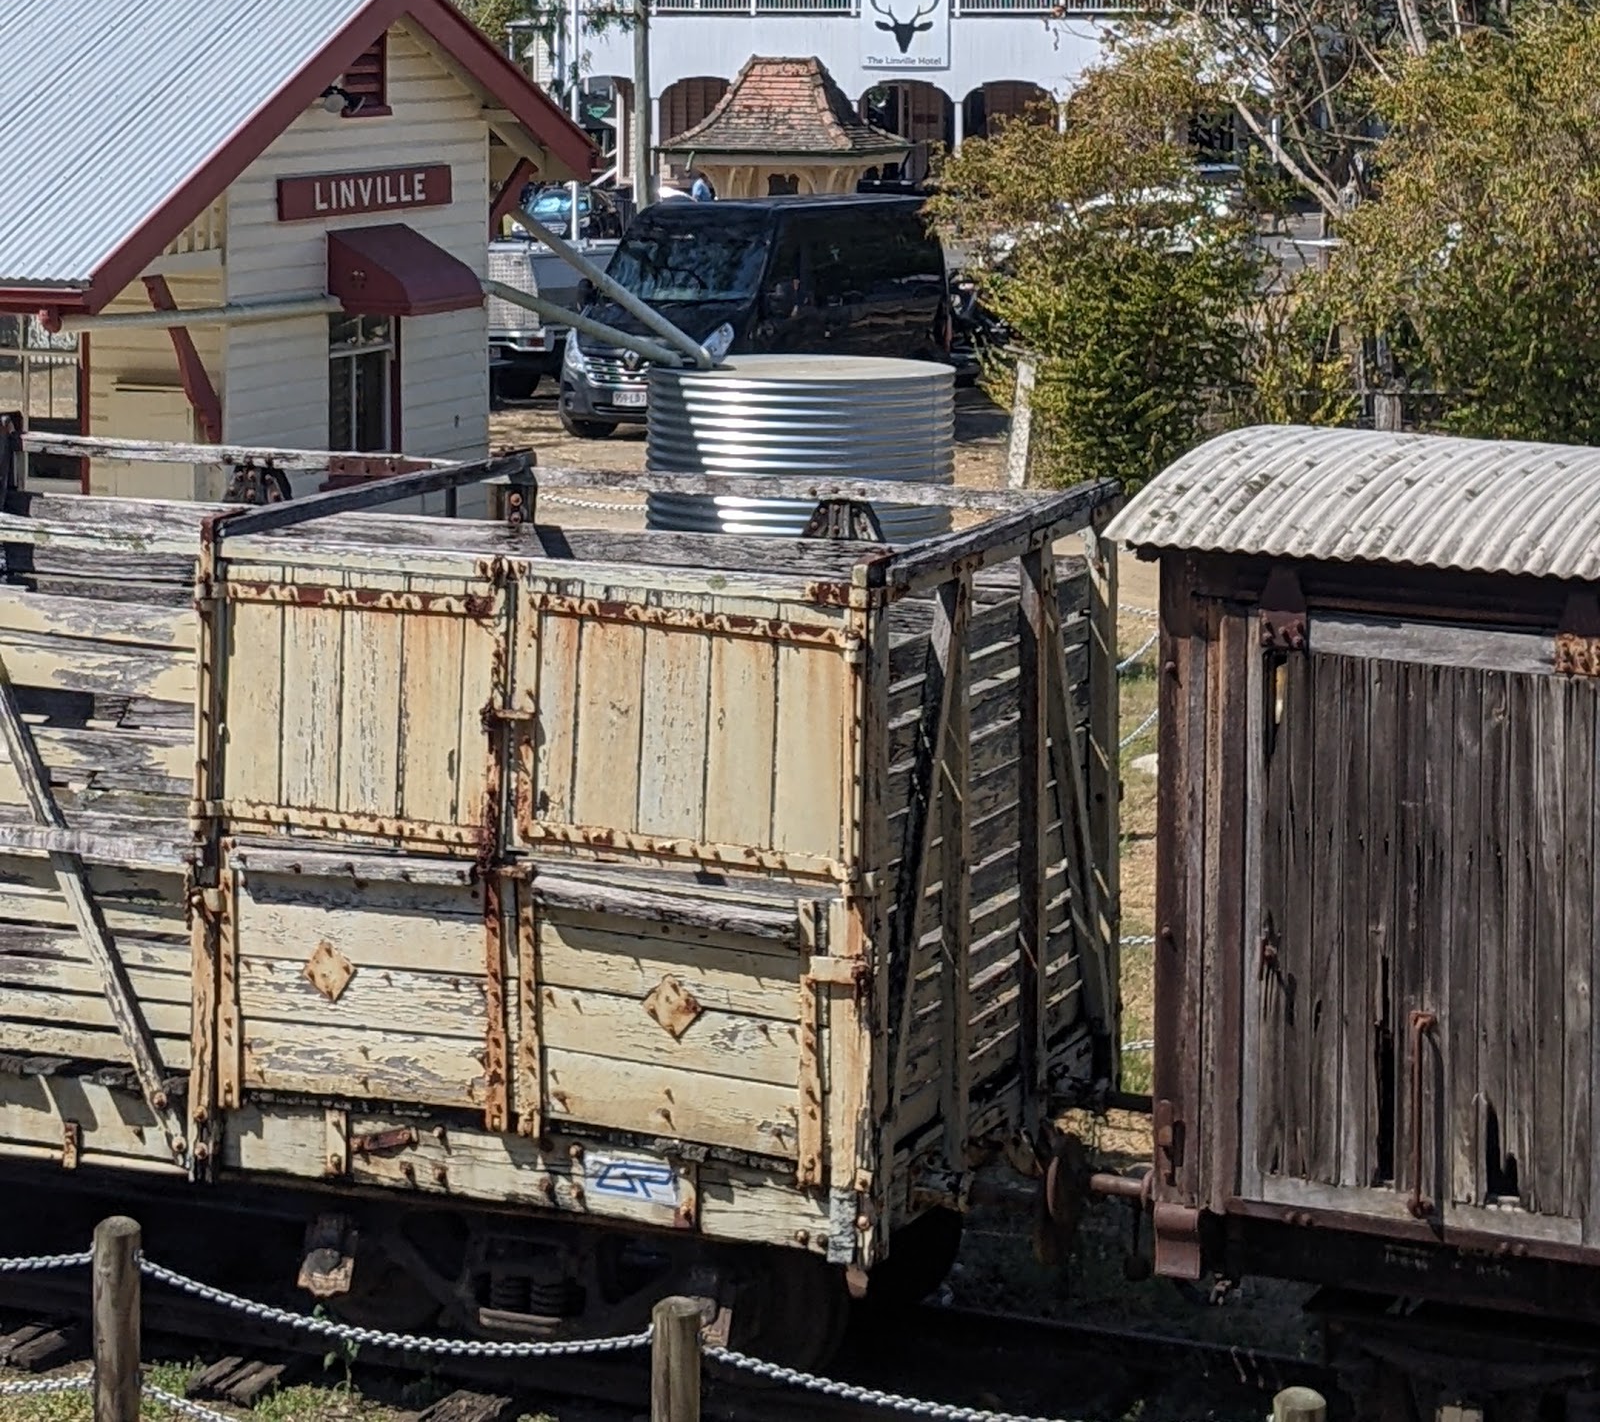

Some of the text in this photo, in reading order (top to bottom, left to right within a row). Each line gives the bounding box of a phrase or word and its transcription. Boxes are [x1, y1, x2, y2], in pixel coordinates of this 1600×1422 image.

[867, 56, 942, 66] The Linville Hotel
[314, 172, 427, 211] LINVILLE
